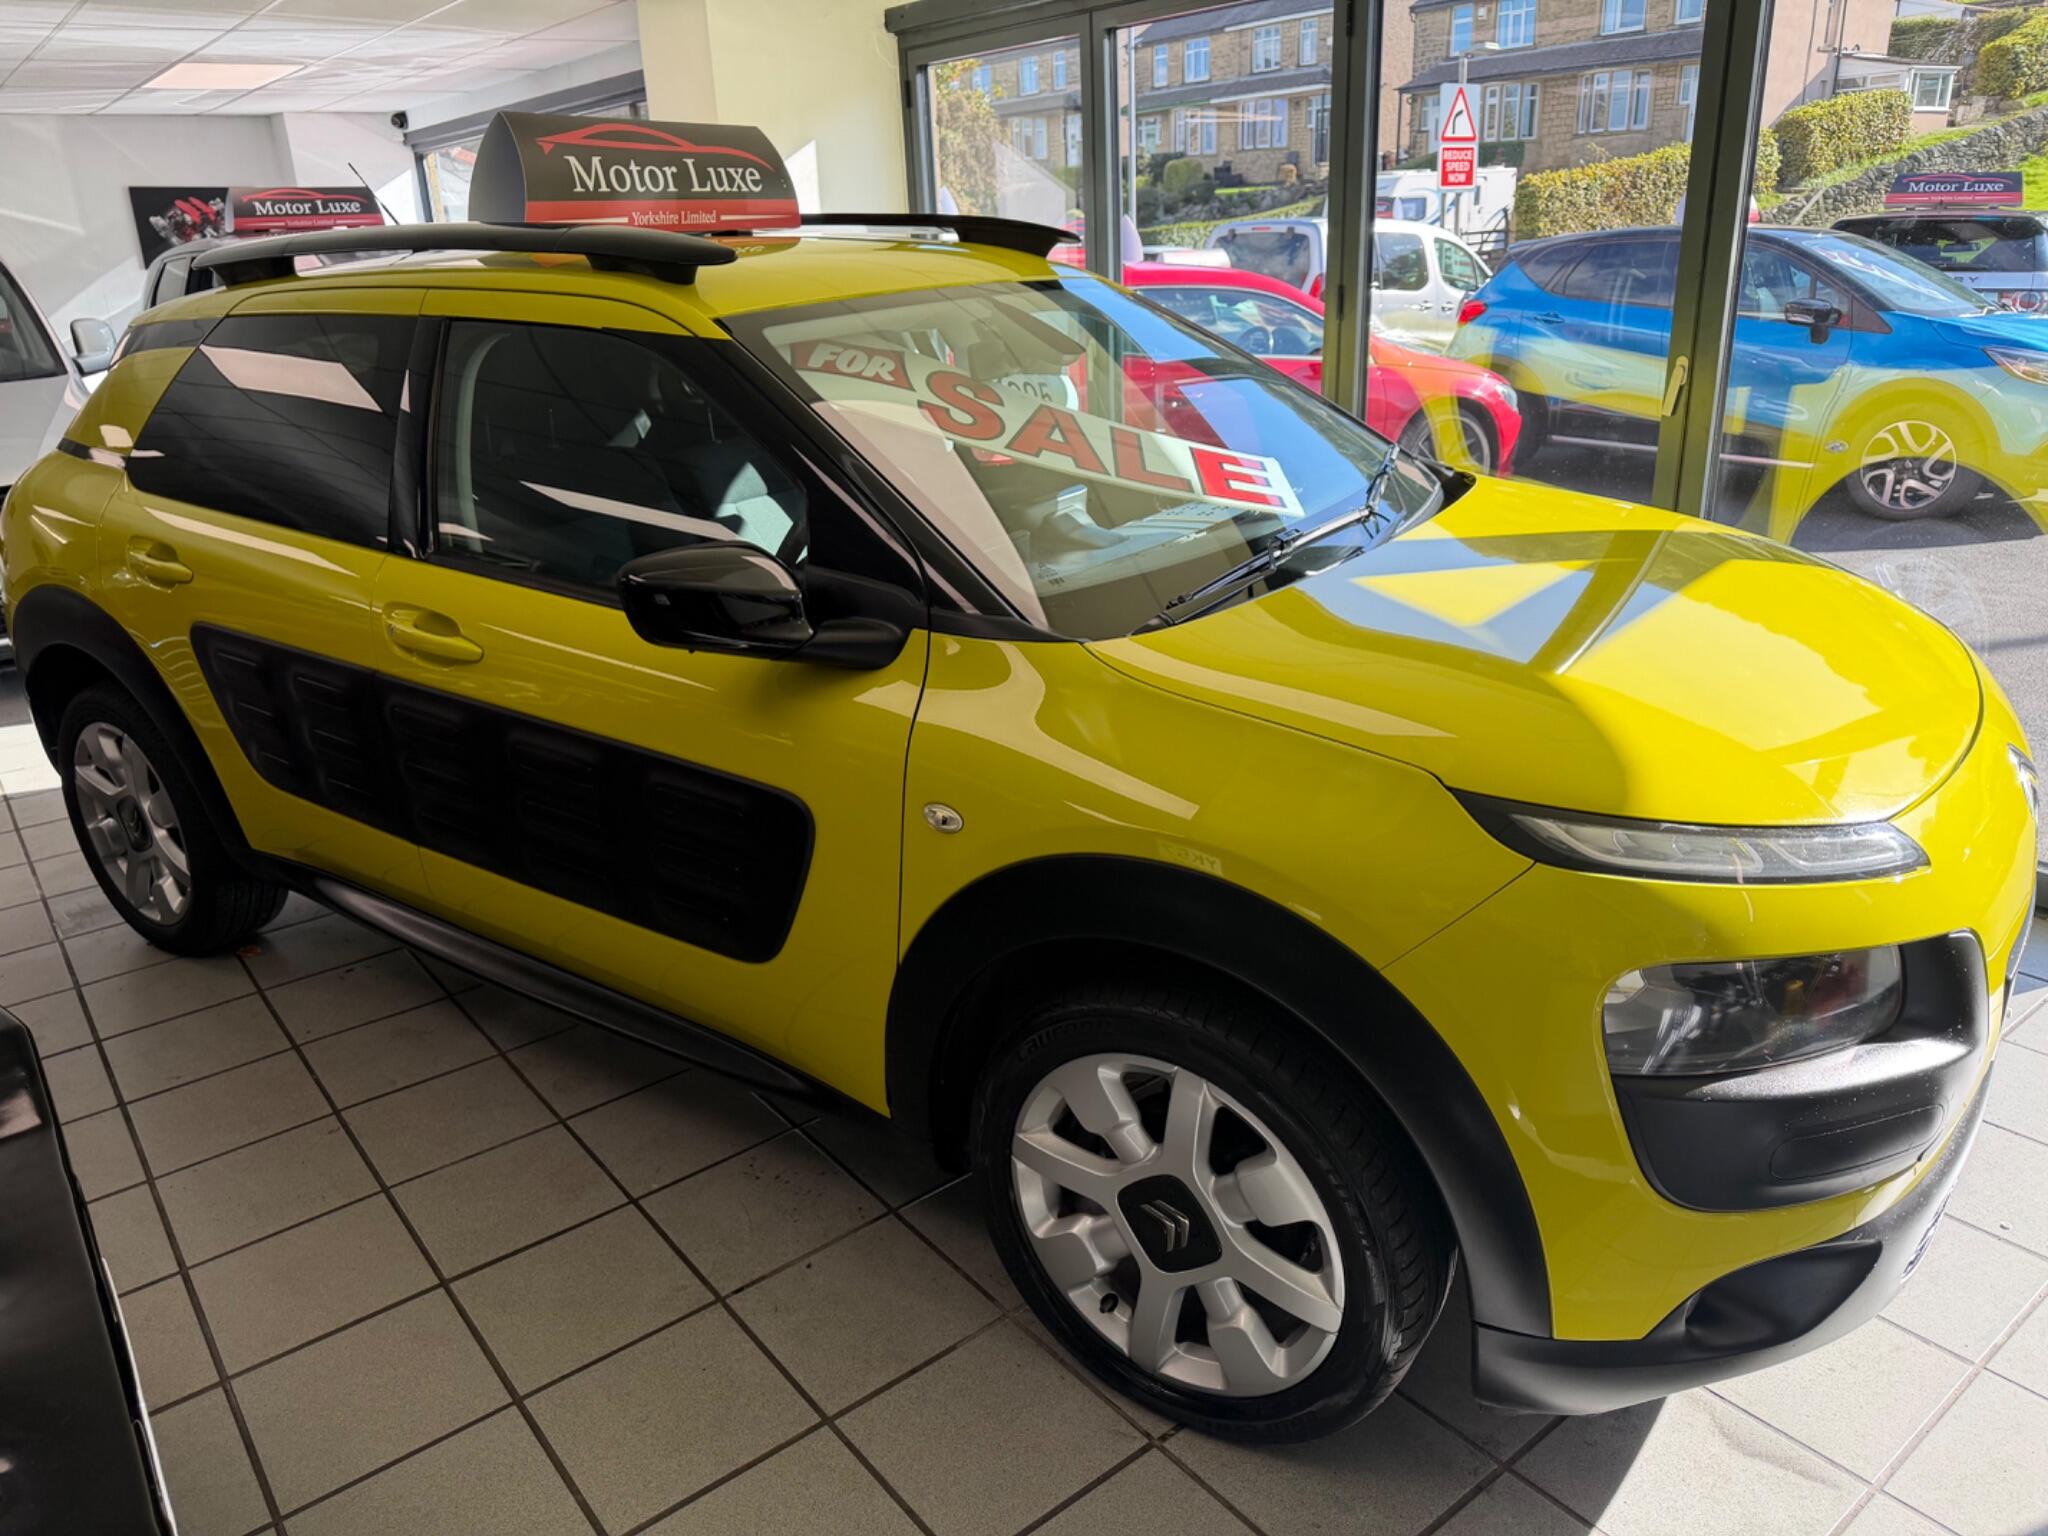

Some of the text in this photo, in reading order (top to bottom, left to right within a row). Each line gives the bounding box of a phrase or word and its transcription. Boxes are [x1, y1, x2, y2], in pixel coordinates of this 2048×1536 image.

[1443, 150, 1473, 160] REDUCE
[1446, 161, 1470, 171] SPEED
[563, 155, 763, 193] Motor Luxe
[1448, 173, 1466, 183] NOW
[1908, 181, 2004, 193] Motor Luxe
[252, 200, 361, 216] Motor Luxe
[632, 210, 716, 225] Yorkshire Limited
[807, 343, 1288, 509] FOR SALE
